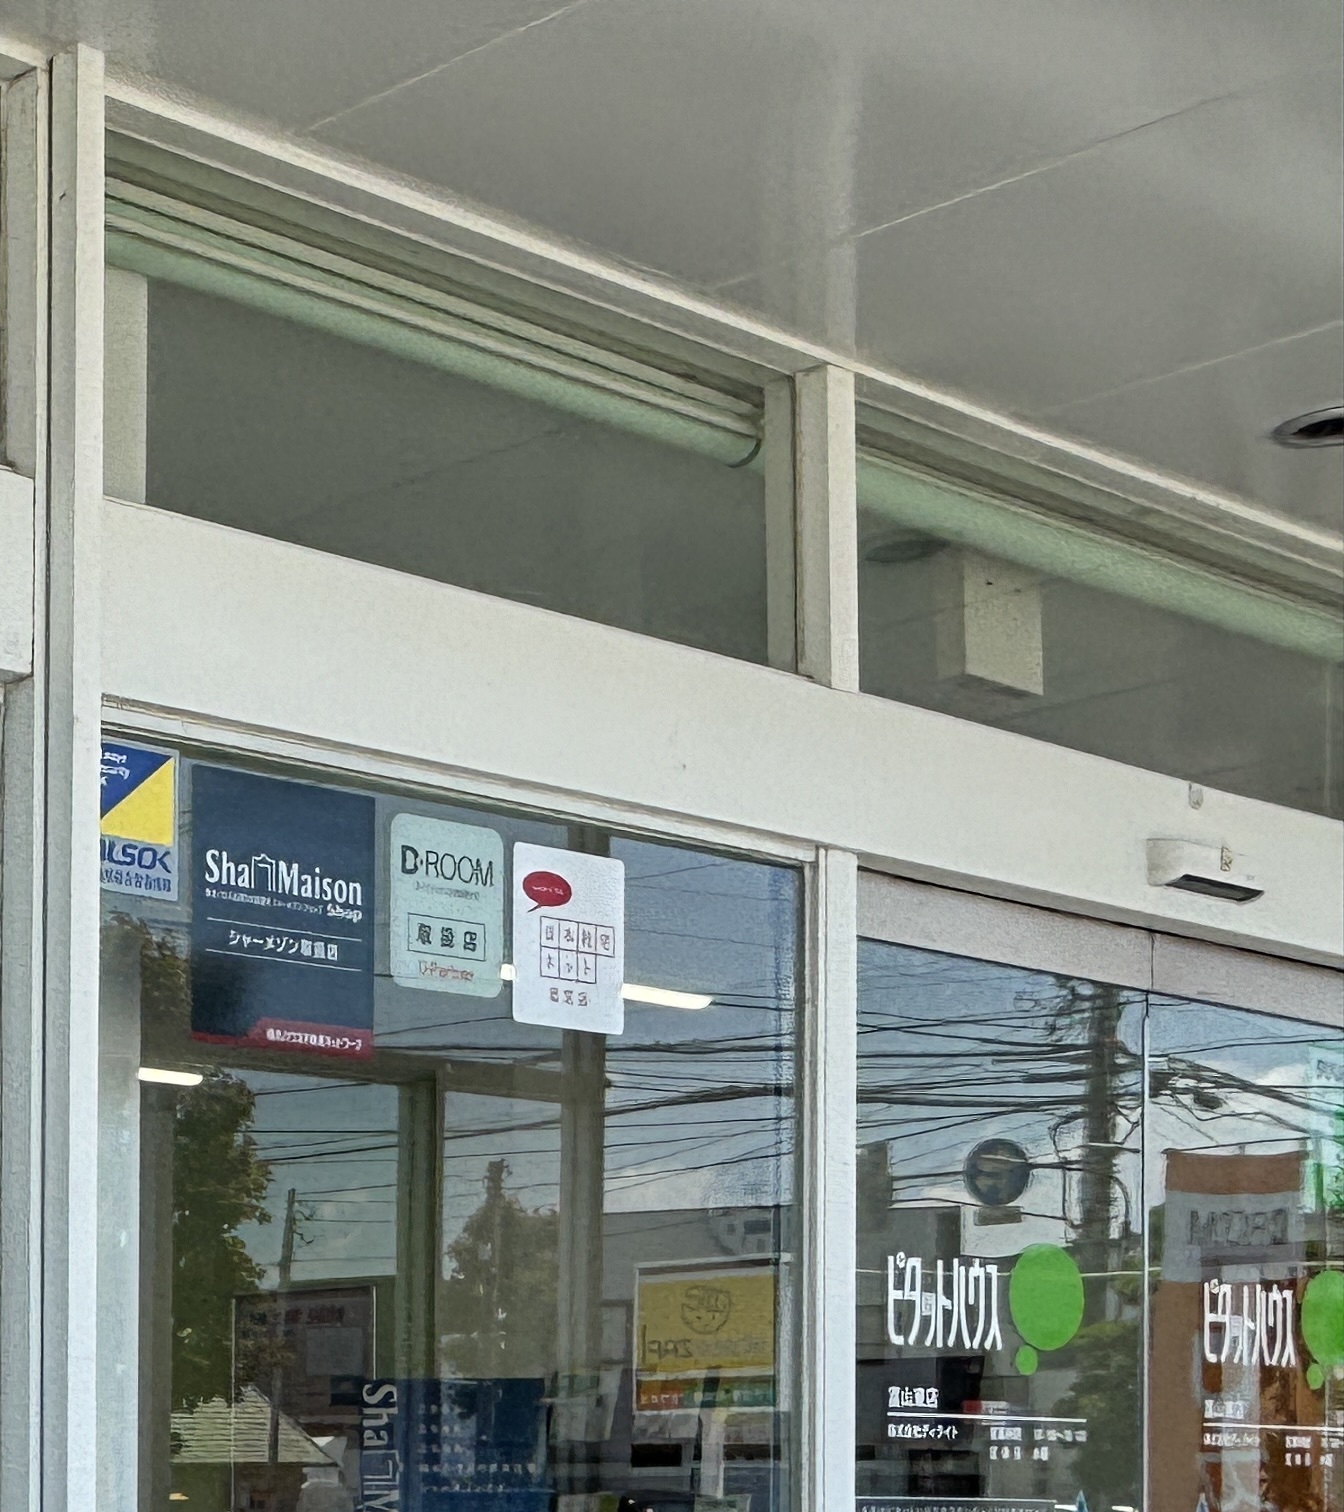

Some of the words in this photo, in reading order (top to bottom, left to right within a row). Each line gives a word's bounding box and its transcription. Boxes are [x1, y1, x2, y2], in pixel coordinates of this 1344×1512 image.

[278, 860, 363, 906] Maison
[887, 1251, 1002, 1351] ピタットハウス
